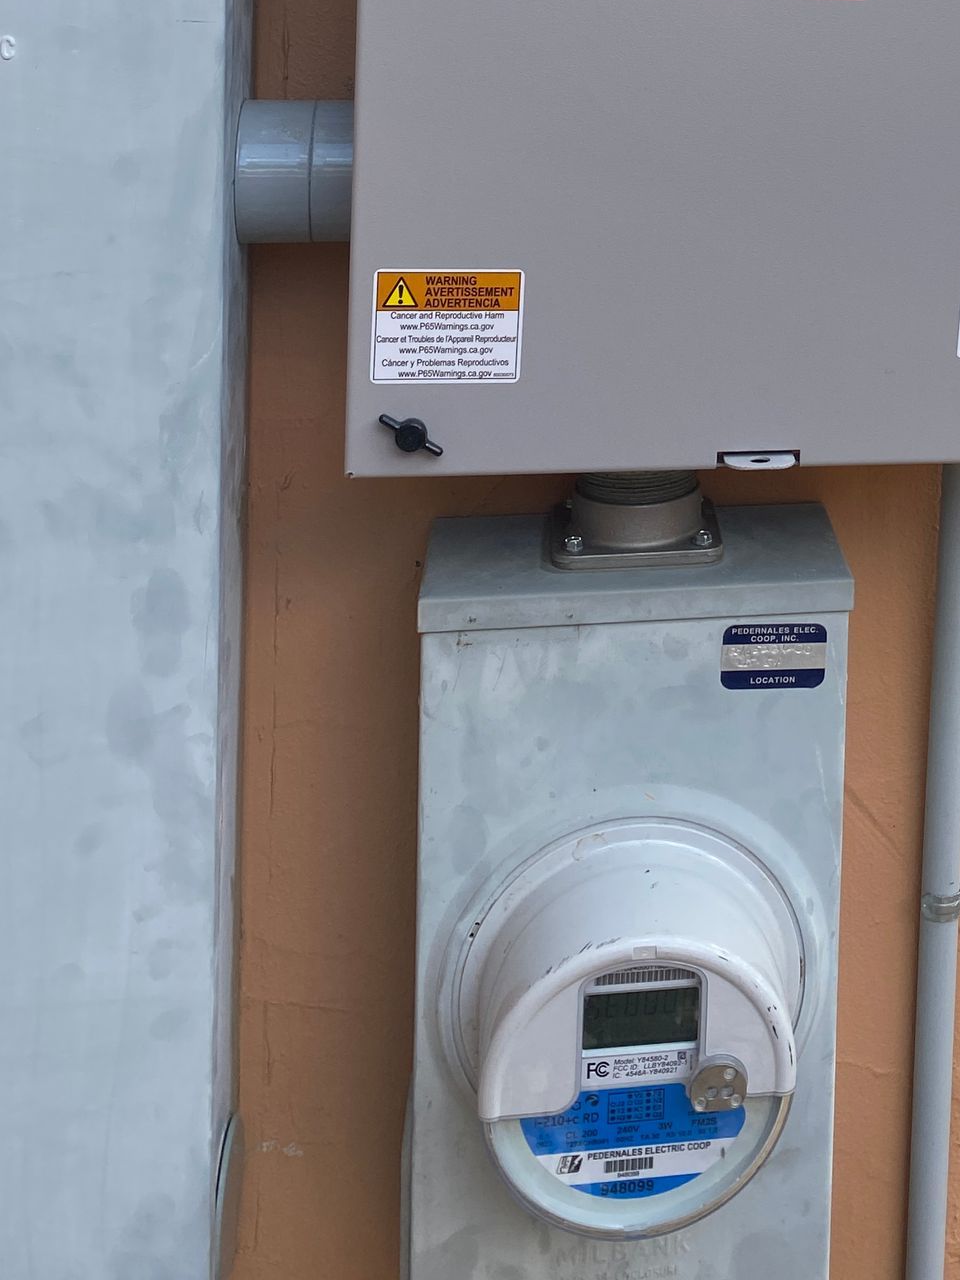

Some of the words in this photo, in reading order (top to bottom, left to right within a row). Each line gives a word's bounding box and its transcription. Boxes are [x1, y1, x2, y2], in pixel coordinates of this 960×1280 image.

[425, 276, 477, 286] WARNING
[424, 287, 514, 297] AVERTISSEMENT
[424, 298, 501, 308] ADVERTENCIA
[390, 311, 417, 320] Cancer
[418, 311, 434, 320] and
[435, 311, 483, 321] Reproductive
[484, 312, 505, 320] Harm
[400, 322, 494, 332] www.P65Warnings.ca.gov
[376, 335, 399, 343] Cancer
[400, 335, 407, 343] et
[408, 334, 435, 343] Troubles
[436, 335, 445, 343] de
[475, 334, 517, 344] Reproducteur
[399, 345, 493, 355] www.P65Warnings.ca.gov
[381, 358, 408, 367] Cáncer
[416, 358, 456, 367] Problemas
[457, 358, 509, 368] Reproductivos
[398, 369, 492, 379] www.P65Warnings.ca.gov
[731, 626, 790, 635] PEDERNALES
[793, 626, 819, 634] ELEC.
[750, 635, 779, 643] COOP,
[781, 634, 799, 642] INC.
[750, 676, 795, 684] LOCATION
[583, 1112, 599, 1123] RD
[587, 1148, 643, 1161] PEDERNALES
[645, 1143, 686, 1155] ELECTRIC
[687, 1141, 712, 1151] COOP
[601, 1180, 654, 1195] 948099
